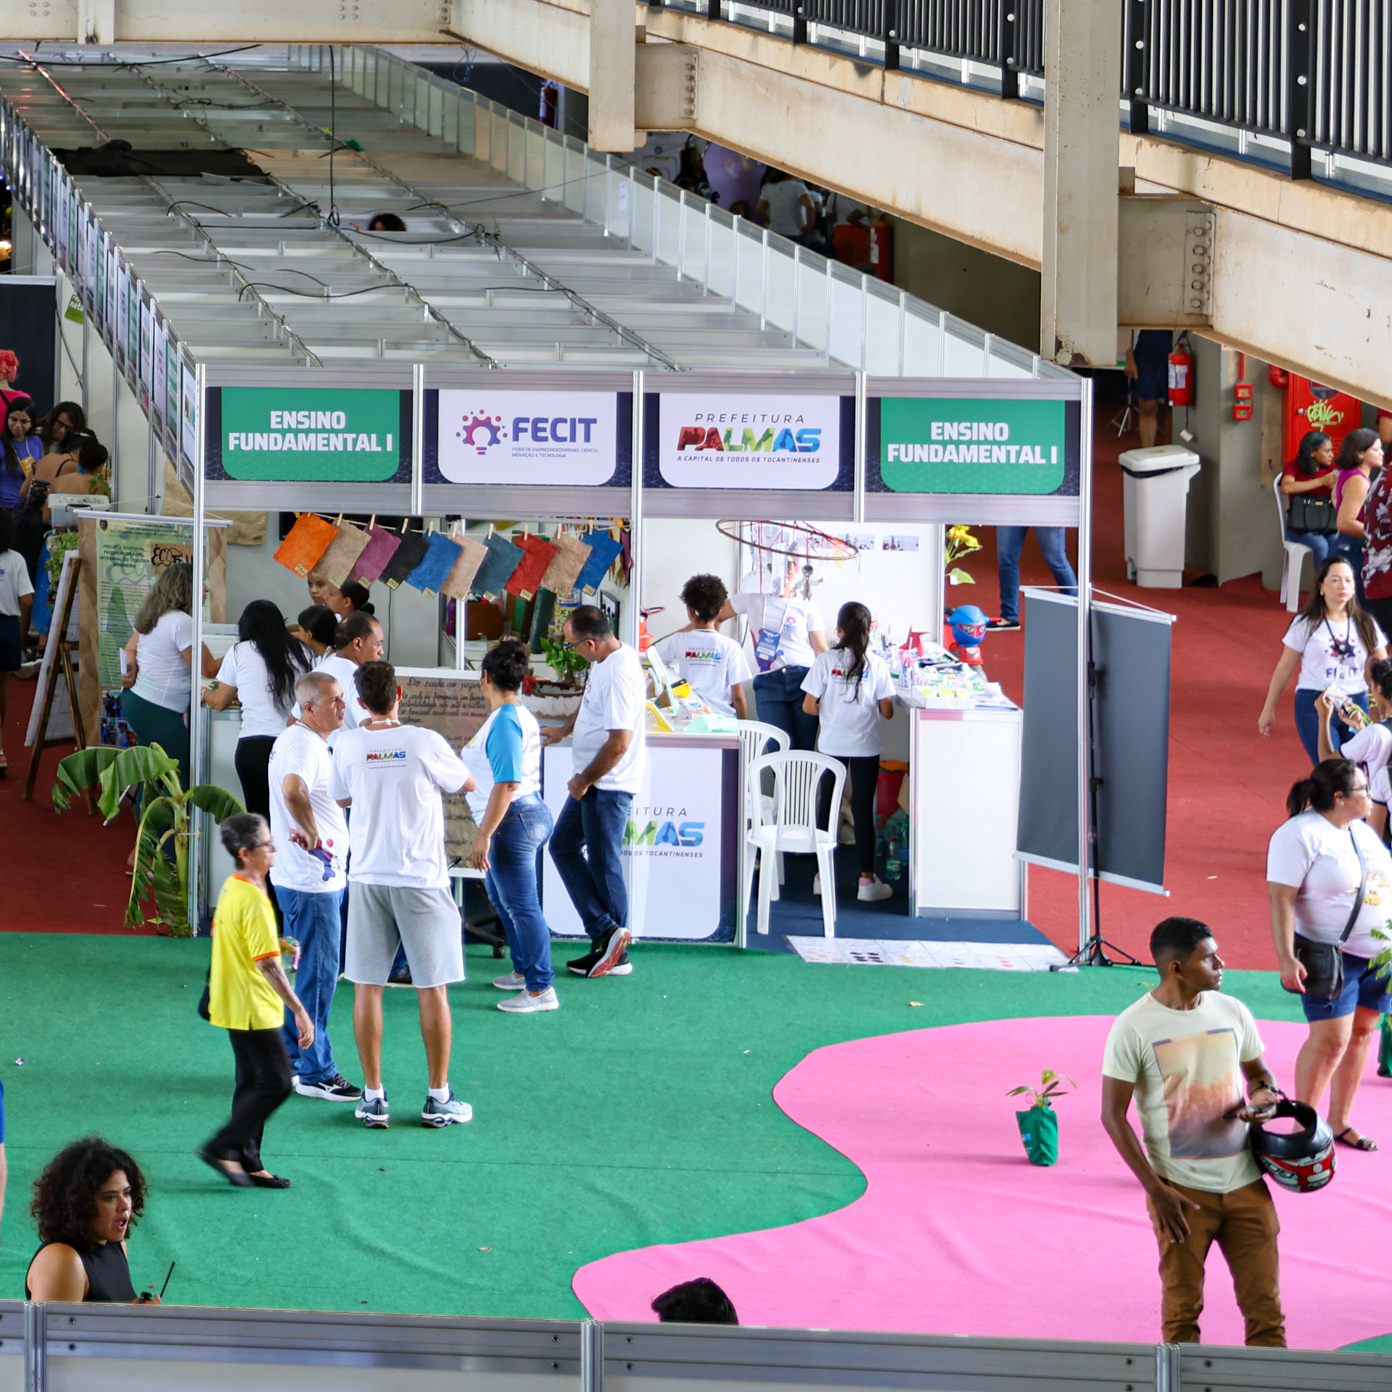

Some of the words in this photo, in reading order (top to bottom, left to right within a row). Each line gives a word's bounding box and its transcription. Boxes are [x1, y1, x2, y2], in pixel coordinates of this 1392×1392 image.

[269, 411, 346, 429] ENSINO
[695, 413, 804, 423] PREFEITURA
[512, 417, 597, 443] FECIT
[677, 426, 822, 453] PALMAS
[930, 421, 1009, 441] ENSINO
[228, 432, 382, 452] FUNDAMENTAL
[386, 433, 392, 452] I
[887, 443, 1046, 464] FUNDAMENTAL
[1051, 445, 1058, 464] I
[685, 651, 722, 660] PALMAS
[367, 751, 406, 761] PALMAS
[622, 821, 705, 847] MAS
